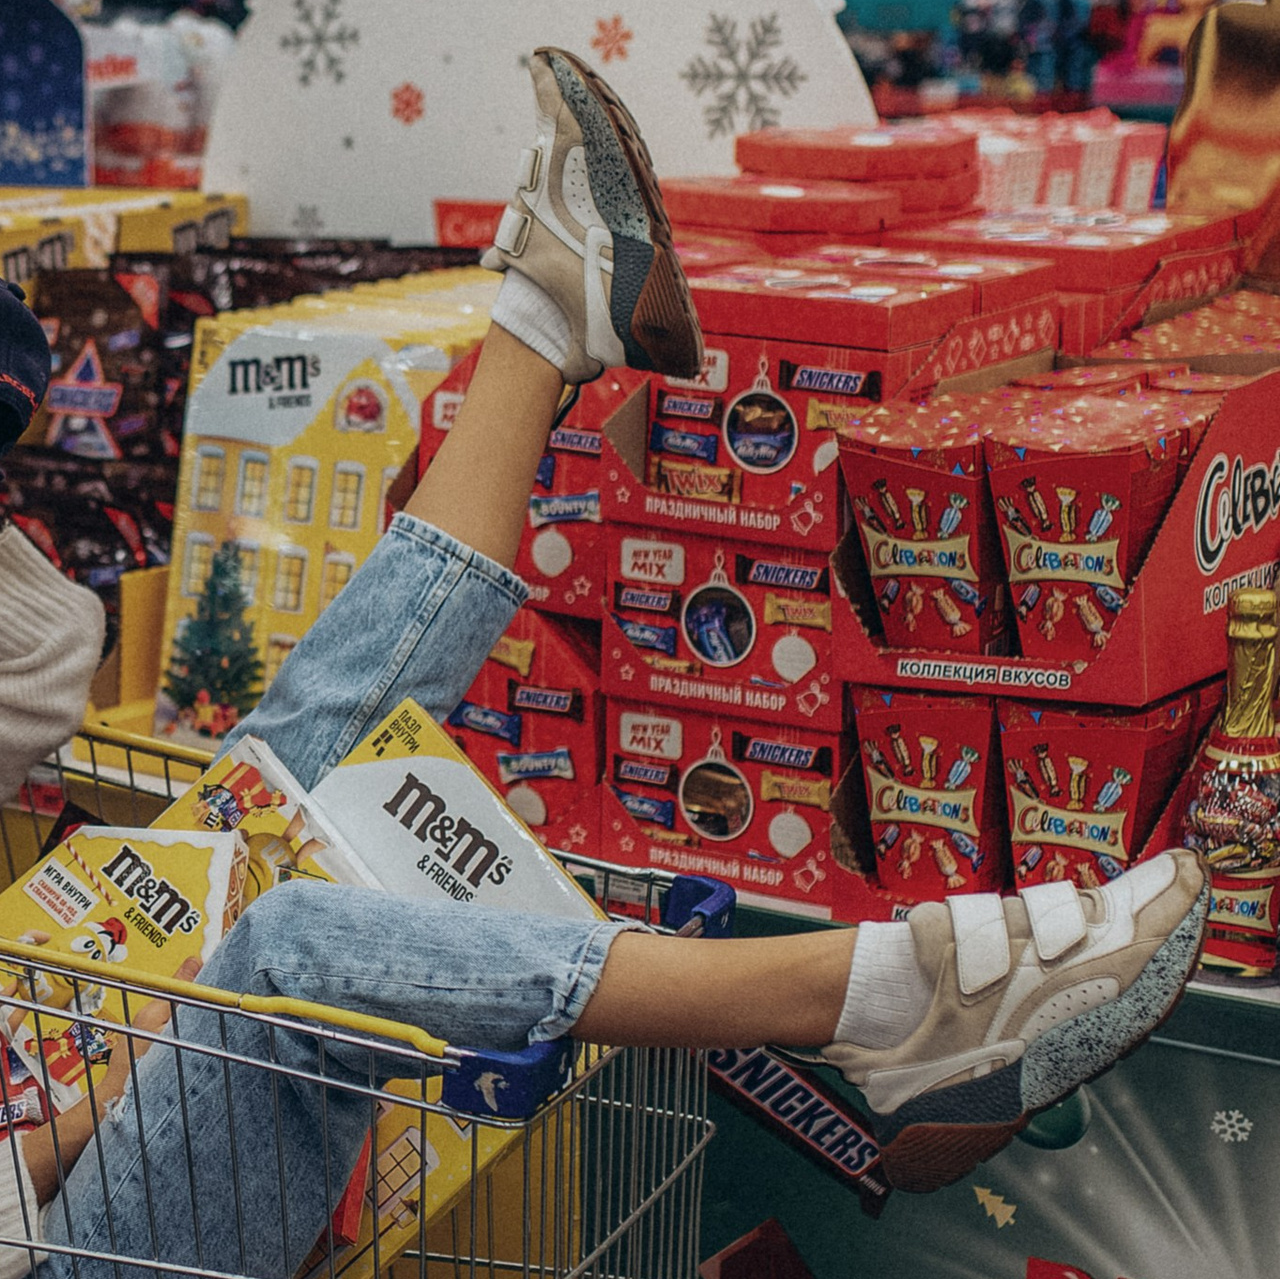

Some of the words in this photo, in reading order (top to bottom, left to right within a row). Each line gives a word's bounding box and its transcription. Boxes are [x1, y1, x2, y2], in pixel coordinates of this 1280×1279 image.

[795, 369, 862, 393] SNICKERS
[663, 399, 712, 419] SNICKERS
[552, 429, 602, 450] SNICKERS
[645, 495, 736, 525] ПРАЗДНИЧНЫЙ
[740, 513, 781, 532] НАБОР
[631, 549, 650, 560] NEW
[652, 550, 673, 560] YEAR
[631, 561, 666, 579] MIX
[752, 563, 819, 589] SNICKERS
[623, 592, 669, 609] SNICKERS
[898, 660, 997, 684] КОЛЛЕКЦИЯ
[1000, 669, 1071, 689] ВКУСОВ
[516, 689, 571, 711] SNICKERS
[650, 675, 742, 705] ПРАЗДНИЧНЫЙ
[745, 692, 786, 711] НАБОР
[398, 709, 422, 735] ПАЗЛ
[630, 723, 650, 734] NEW
[651, 724, 670, 735] YEAR
[389, 719, 420, 754] ВНУТРИ
[629, 736, 664, 753] MIX
[748, 741, 814, 767] SNICKERS
[622, 763, 668, 782] SNICKERS
[383, 772, 512, 889] m&m's
[416, 854, 431, 871] &
[426, 861, 477, 903] FRIENDS
[649, 847, 740, 878] ПРАЗДНИЧНЫЙ
[743, 863, 784, 886] НАБОР
[43, 864, 64, 887] ИГРА
[61, 882, 93, 911] ВНУТРИ
[101, 844, 201, 935] m&m's
[123, 907, 135, 920] &
[131, 913, 169, 949] FRIENDS
[708, 1048, 880, 1173] SNICKERS
